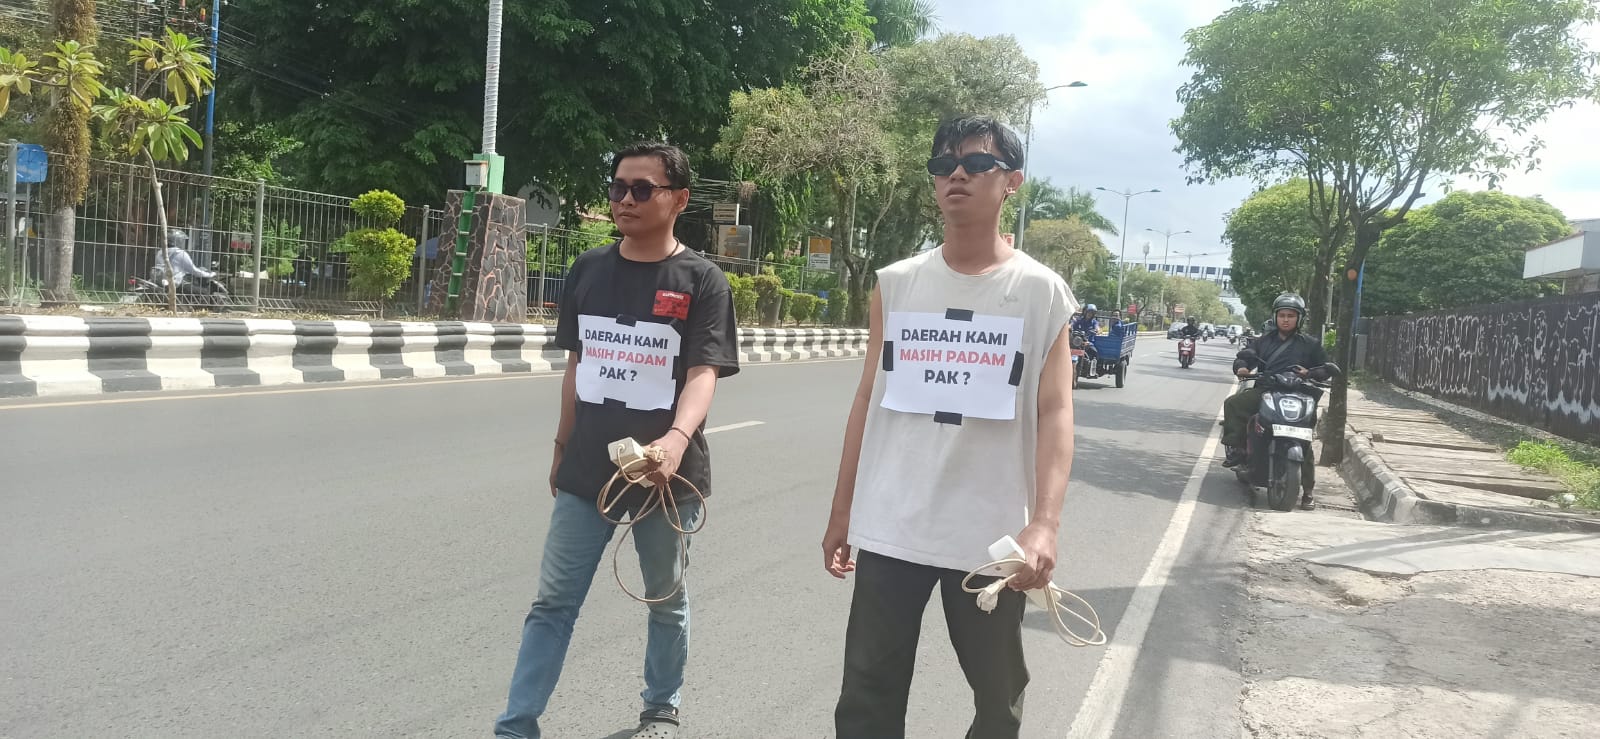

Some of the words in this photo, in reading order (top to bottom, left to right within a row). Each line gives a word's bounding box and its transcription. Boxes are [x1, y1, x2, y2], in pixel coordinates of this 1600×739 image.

[585, 329, 631, 346] DAERAH
[634, 335, 668, 350] KAMI
[901, 328, 961, 343] DAERAH
[965, 331, 1008, 346] KAMI
[585, 346, 614, 361] MASIH
[617, 351, 667, 367] PADAM
[899, 348, 942, 362] MASIH
[946, 351, 1006, 367] PADAM
[600, 366, 626, 381] PAK
[630, 370, 638, 382] ?
[924, 369, 959, 385] PAK
[962, 371, 971, 385] ?
